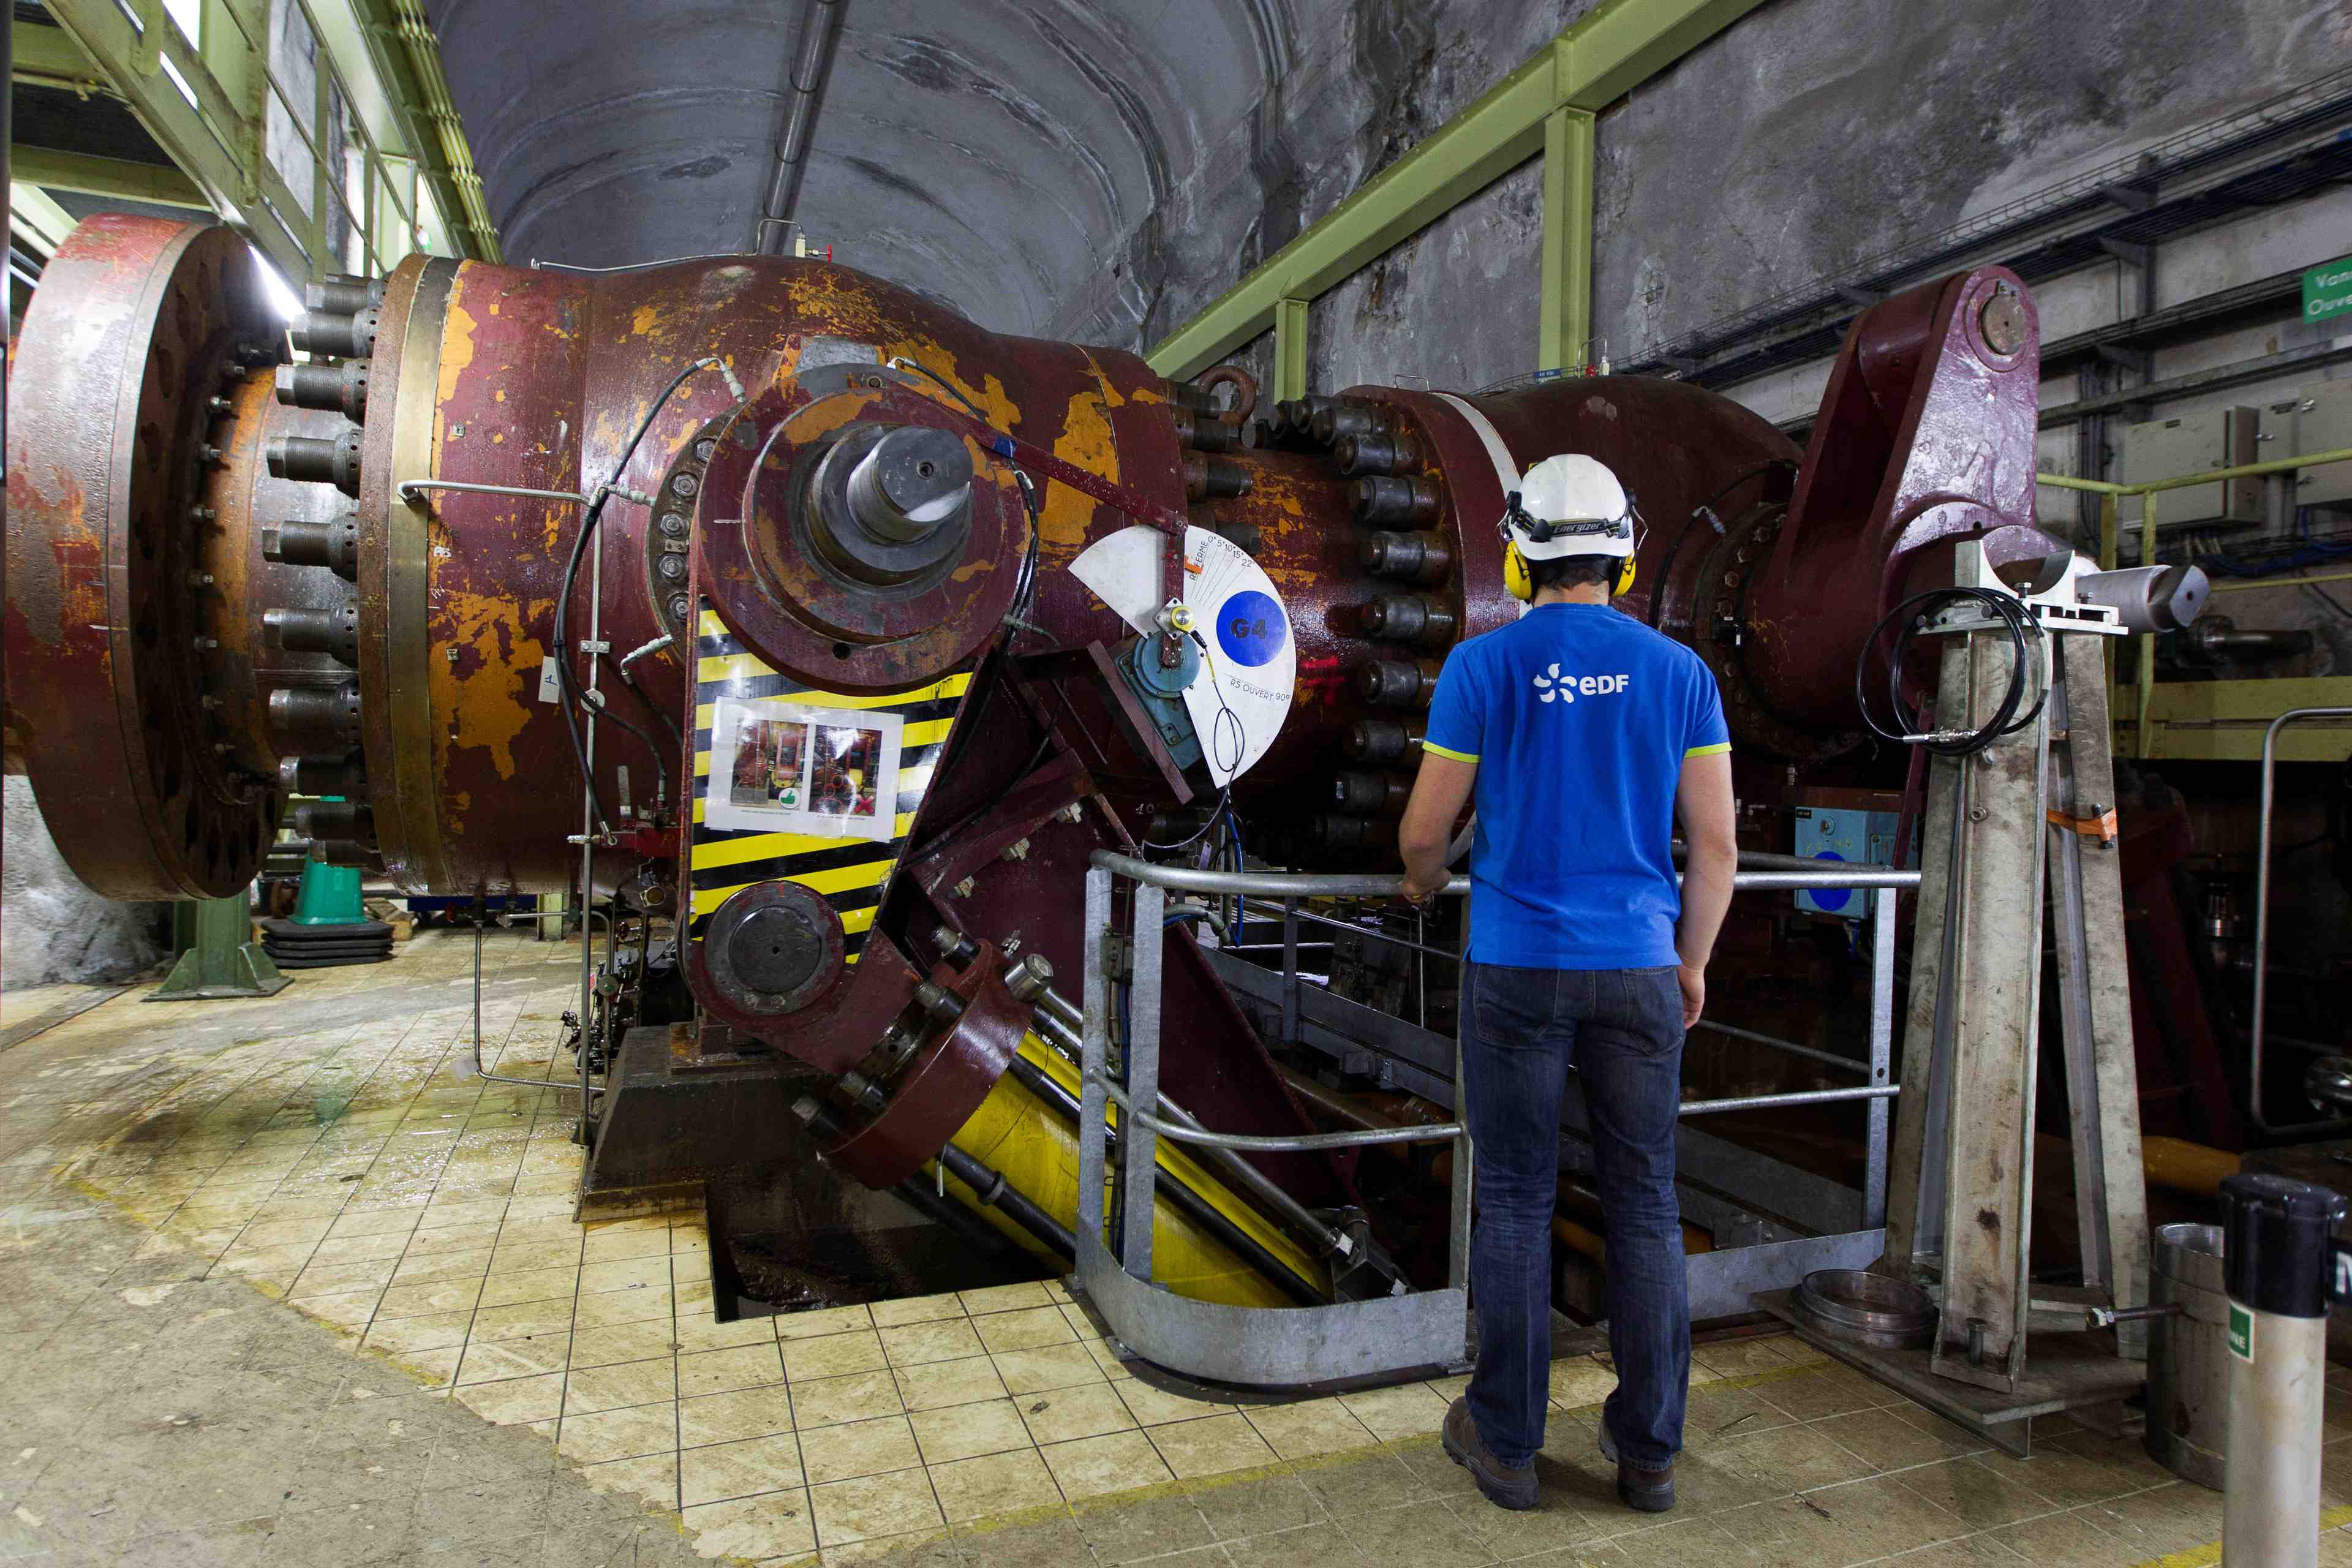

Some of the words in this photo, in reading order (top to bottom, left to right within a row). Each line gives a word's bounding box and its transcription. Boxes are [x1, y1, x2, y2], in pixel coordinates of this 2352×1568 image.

[1553, 522, 1601, 533] Energizer
[1231, 618, 1266, 639] G4
[1231, 678, 1241, 688] RS
[1243, 684, 1273, 701] OUVERT
